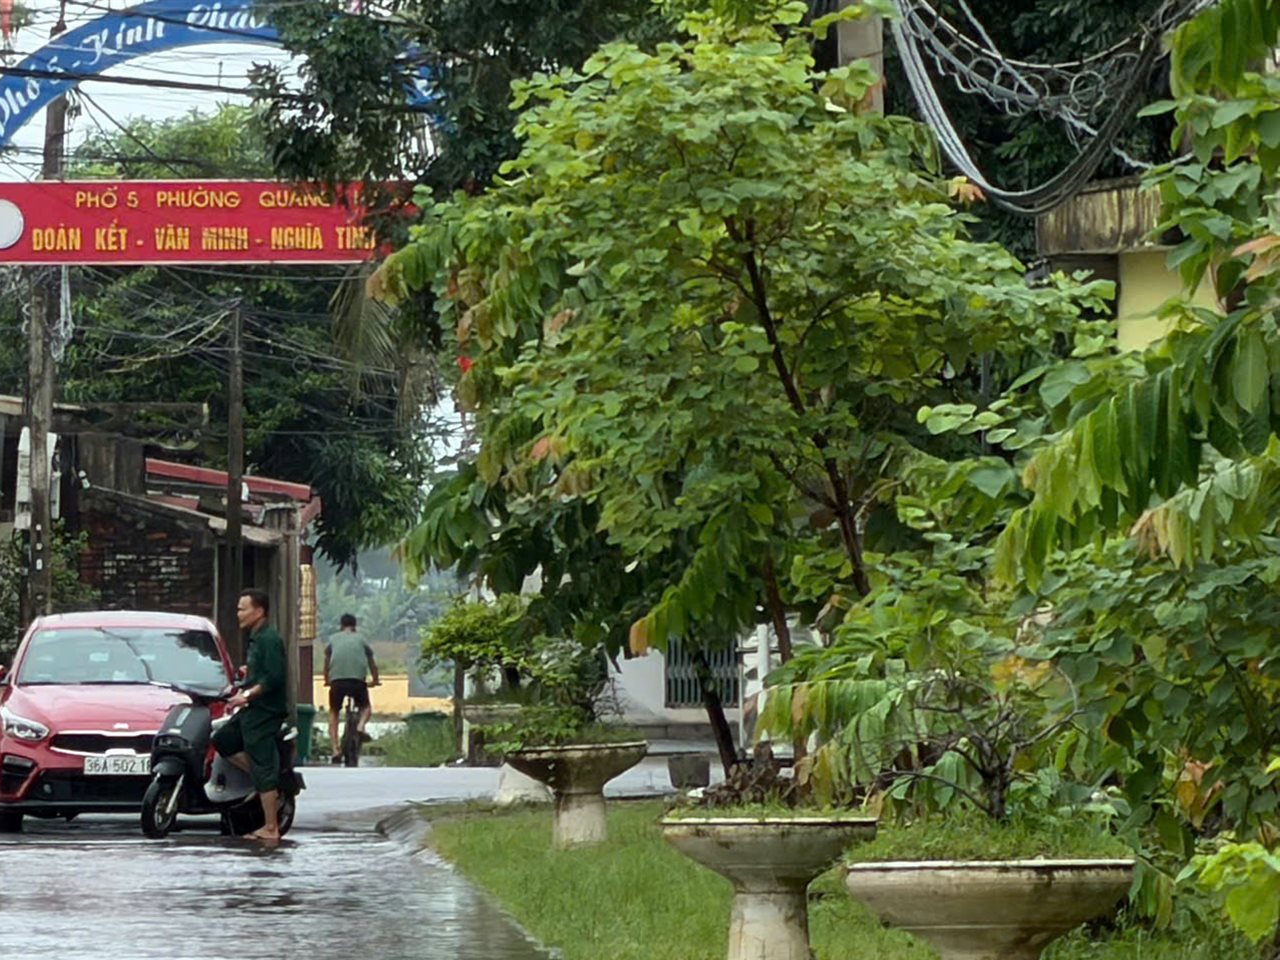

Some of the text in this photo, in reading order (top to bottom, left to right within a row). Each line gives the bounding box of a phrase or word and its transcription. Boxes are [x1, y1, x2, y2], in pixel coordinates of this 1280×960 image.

[81, 17, 165, 66] Kính
[75, 186, 118, 208] PHỐ
[127, 191, 139, 208] 5
[157, 186, 241, 208] PHƯỜNG
[32, 223, 81, 250] ĐOÀN
[95, 218, 128, 250] KẾT
[155, 223, 190, 250] VĂN
[202, 227, 248, 250] MINH
[271, 222, 323, 250] NGHĨA
